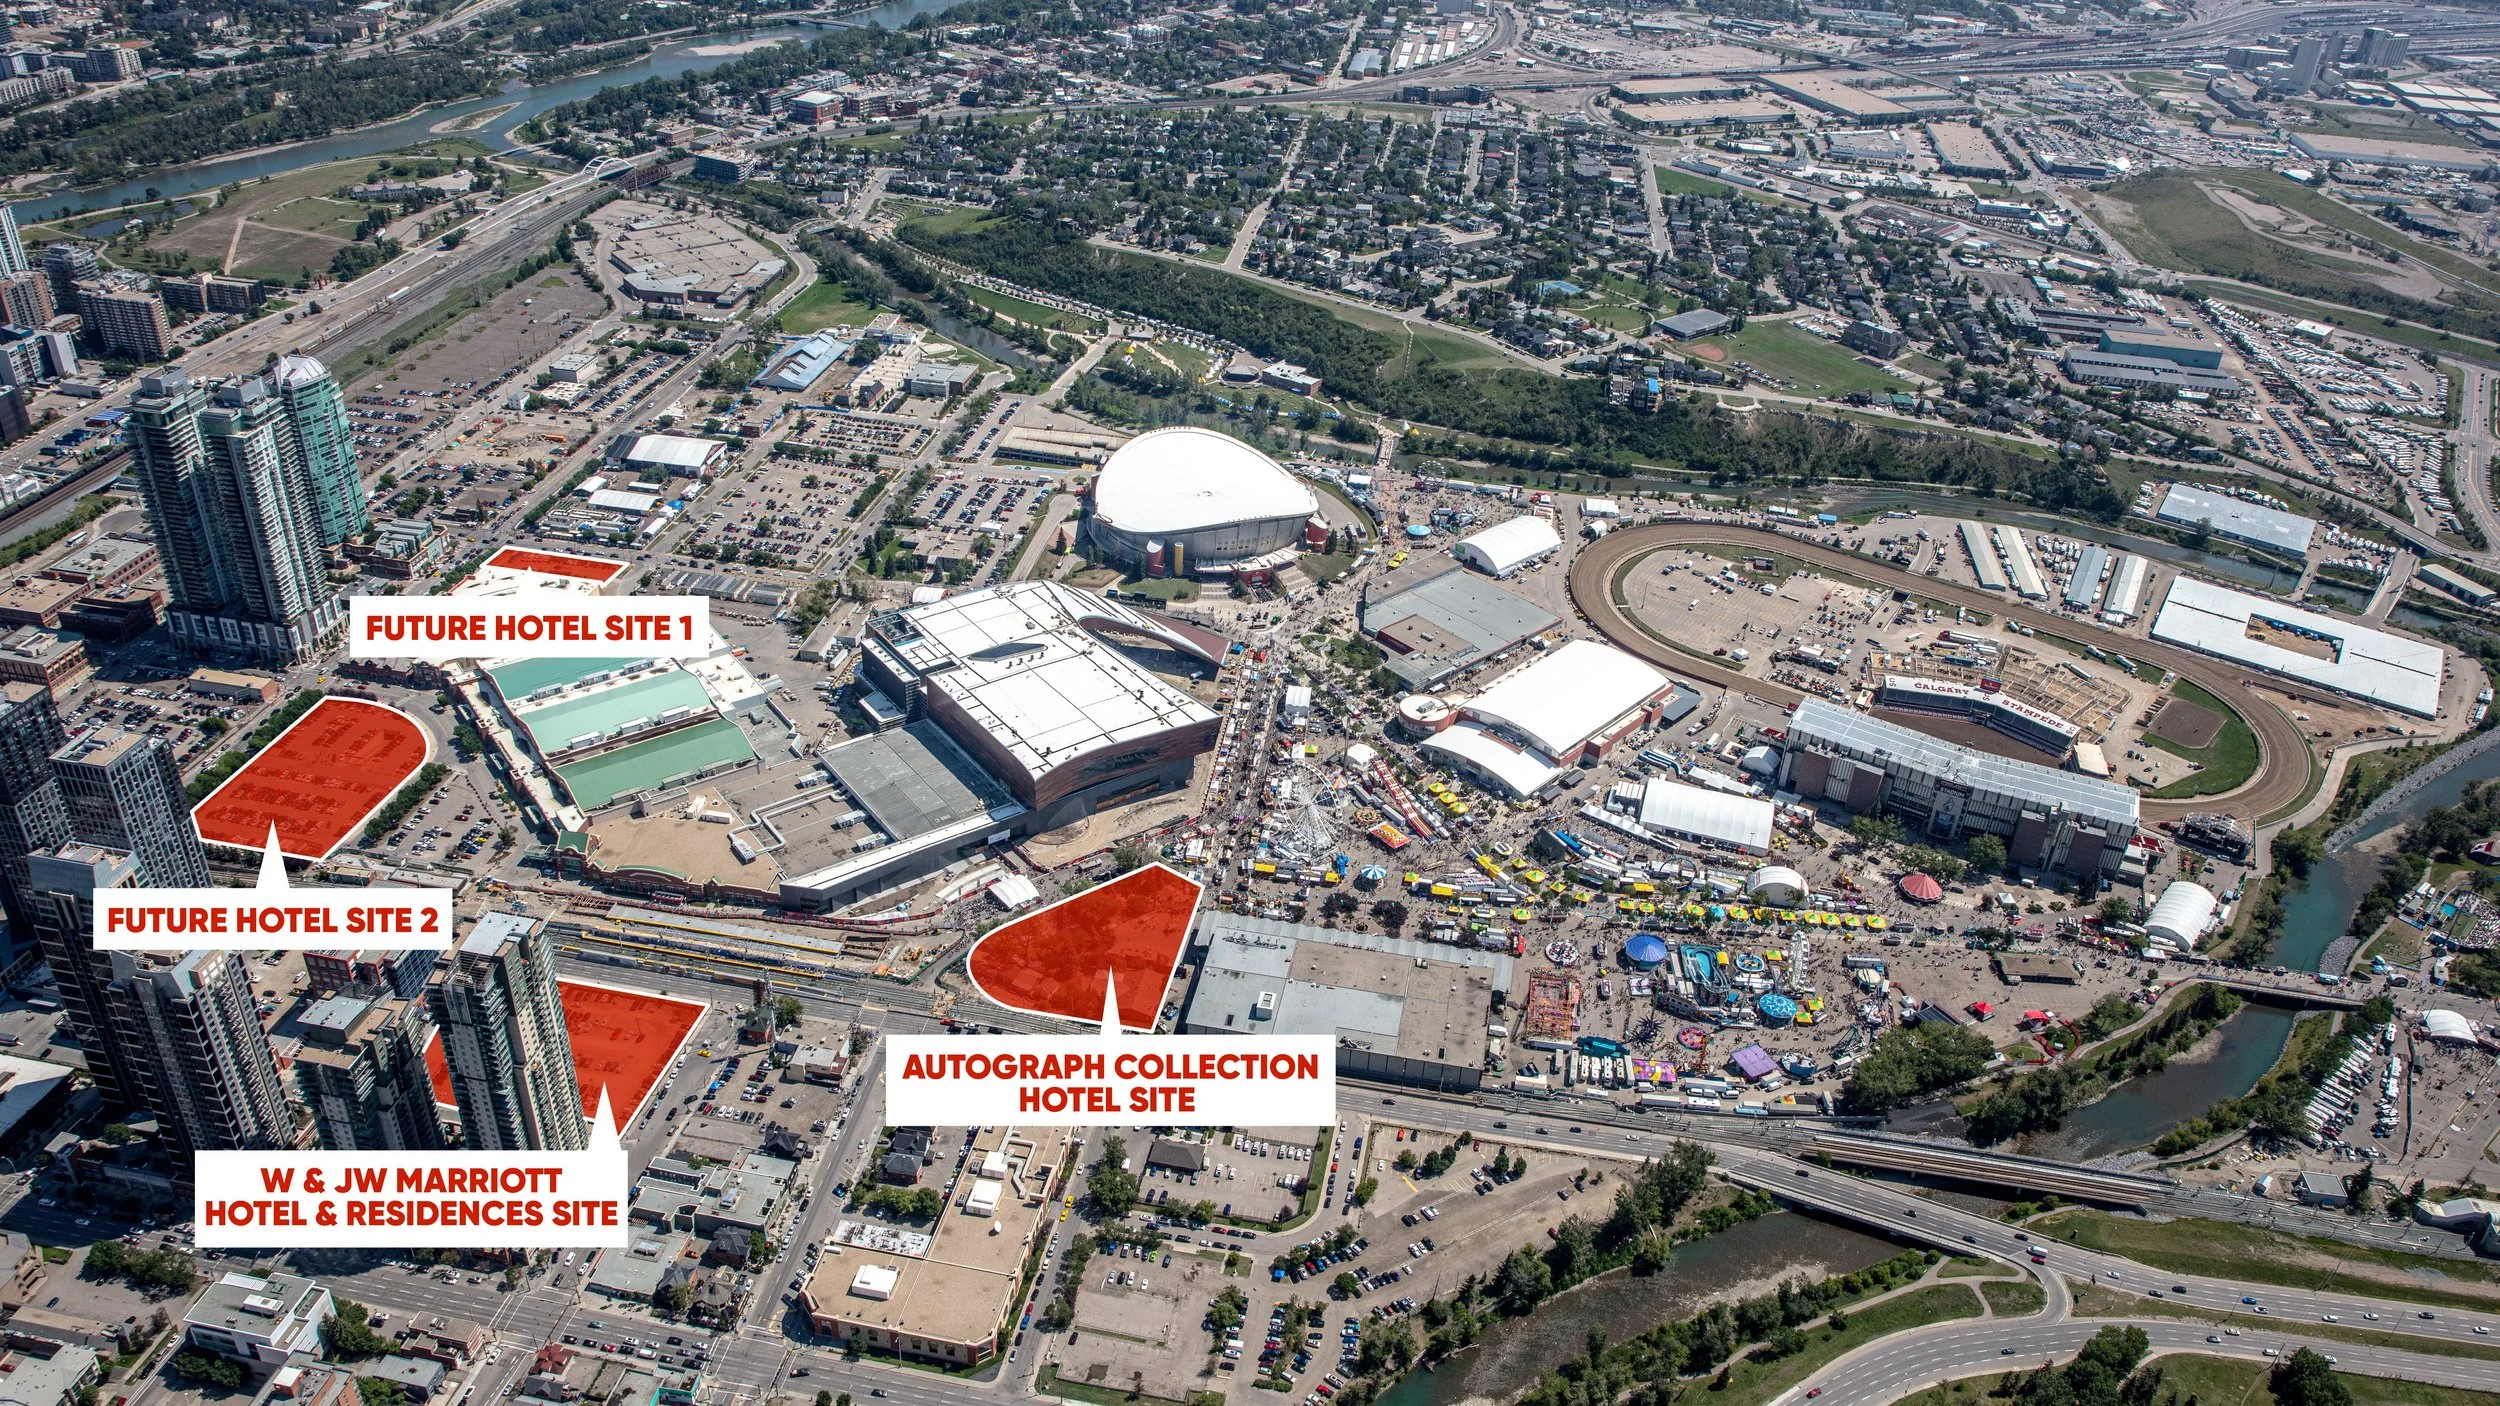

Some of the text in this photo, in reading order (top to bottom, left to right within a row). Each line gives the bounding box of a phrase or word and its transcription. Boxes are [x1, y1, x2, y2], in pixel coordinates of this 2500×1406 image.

[1914, 682, 1970, 695] CALGARY
[2001, 699, 2065, 729] STAMPEDE
[1939, 787, 1965, 798] STADIUM
